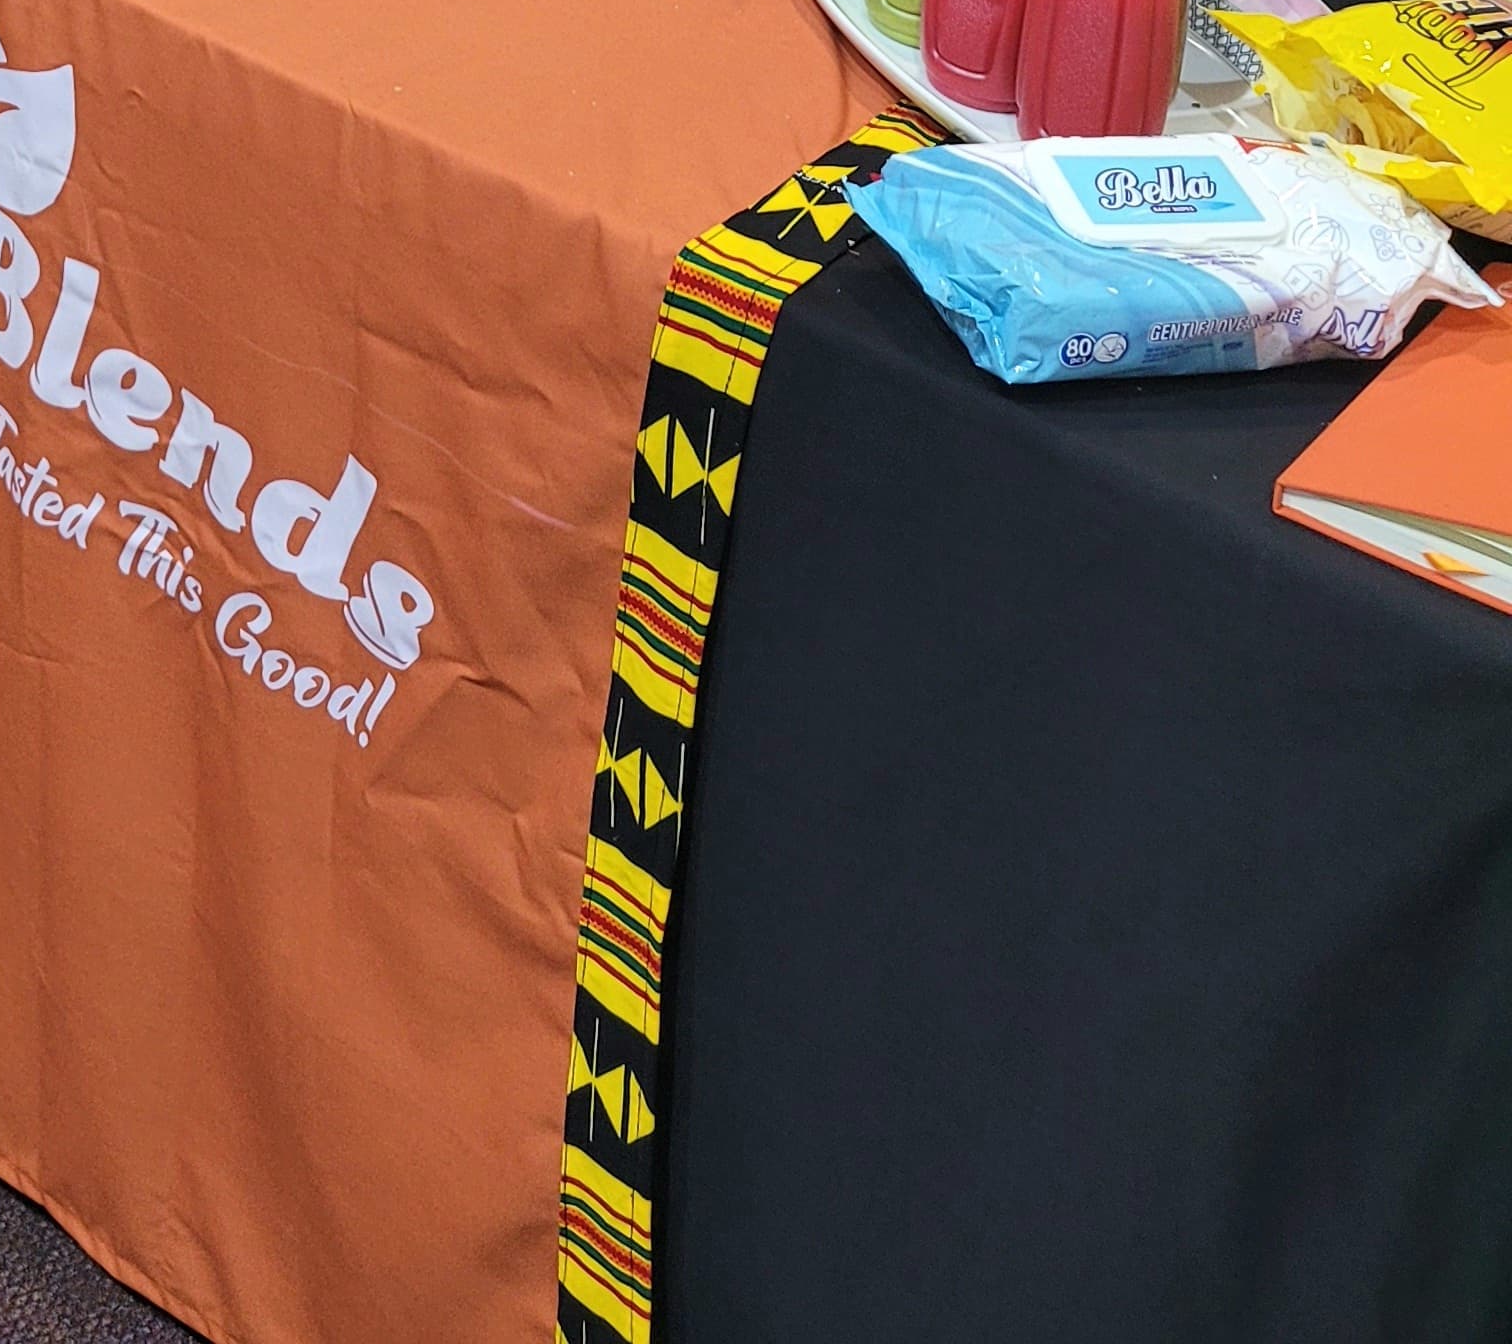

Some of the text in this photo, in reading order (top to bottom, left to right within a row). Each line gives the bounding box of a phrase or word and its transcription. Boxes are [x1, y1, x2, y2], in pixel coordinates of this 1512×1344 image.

[1095, 164, 1217, 210] Bella
[1066, 337, 1090, 359] 80
[115, 501, 204, 616] This
[214, 590, 395, 749] Good!
